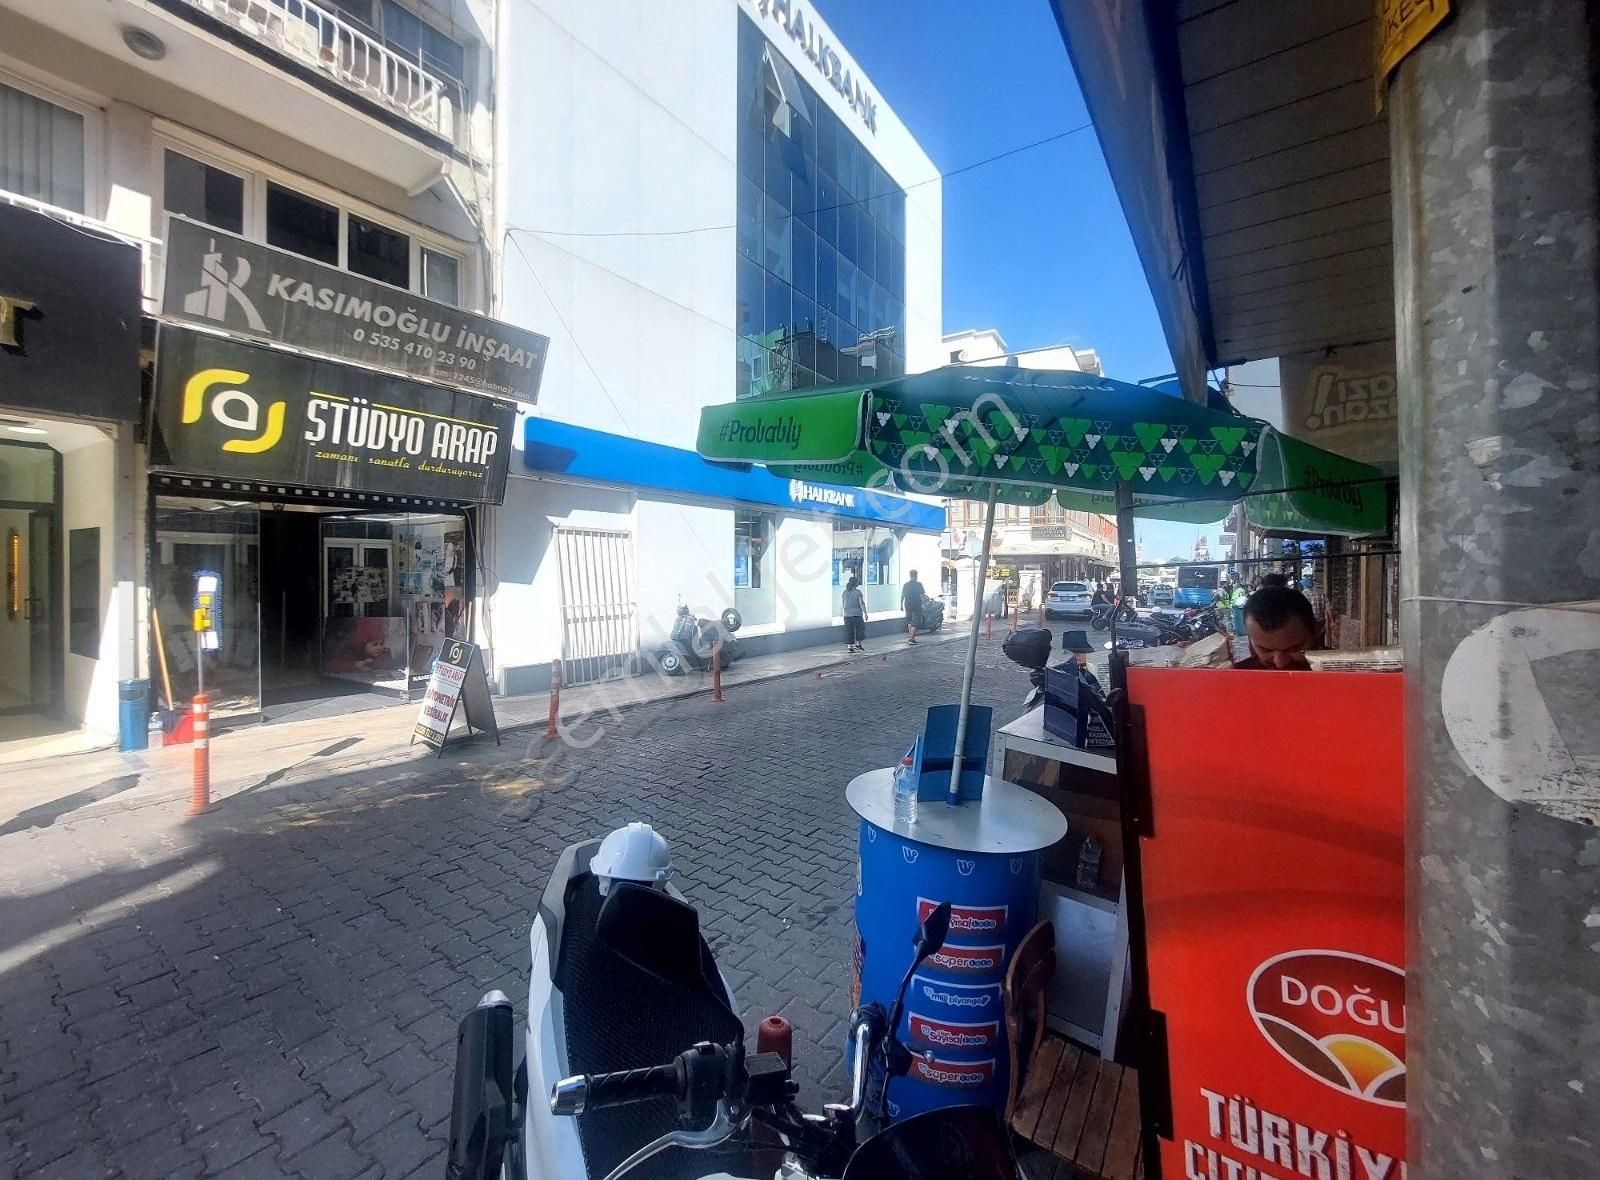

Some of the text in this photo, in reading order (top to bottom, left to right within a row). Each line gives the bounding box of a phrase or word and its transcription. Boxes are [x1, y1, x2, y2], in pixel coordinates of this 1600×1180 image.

[266, 273, 538, 369] KASIMOĞLU İNŞAAT
[353, 328, 476, 370] 0 535 410 23 90
[431, 422, 498, 465] ARAP
[720, 416, 802, 450] #Probably
[315, 450, 483, 478] zamanı sanatla durduruyoruz
[803, 484, 855, 507] HALKBANK
[1200, 1086, 1406, 1180] TÜRKİY
